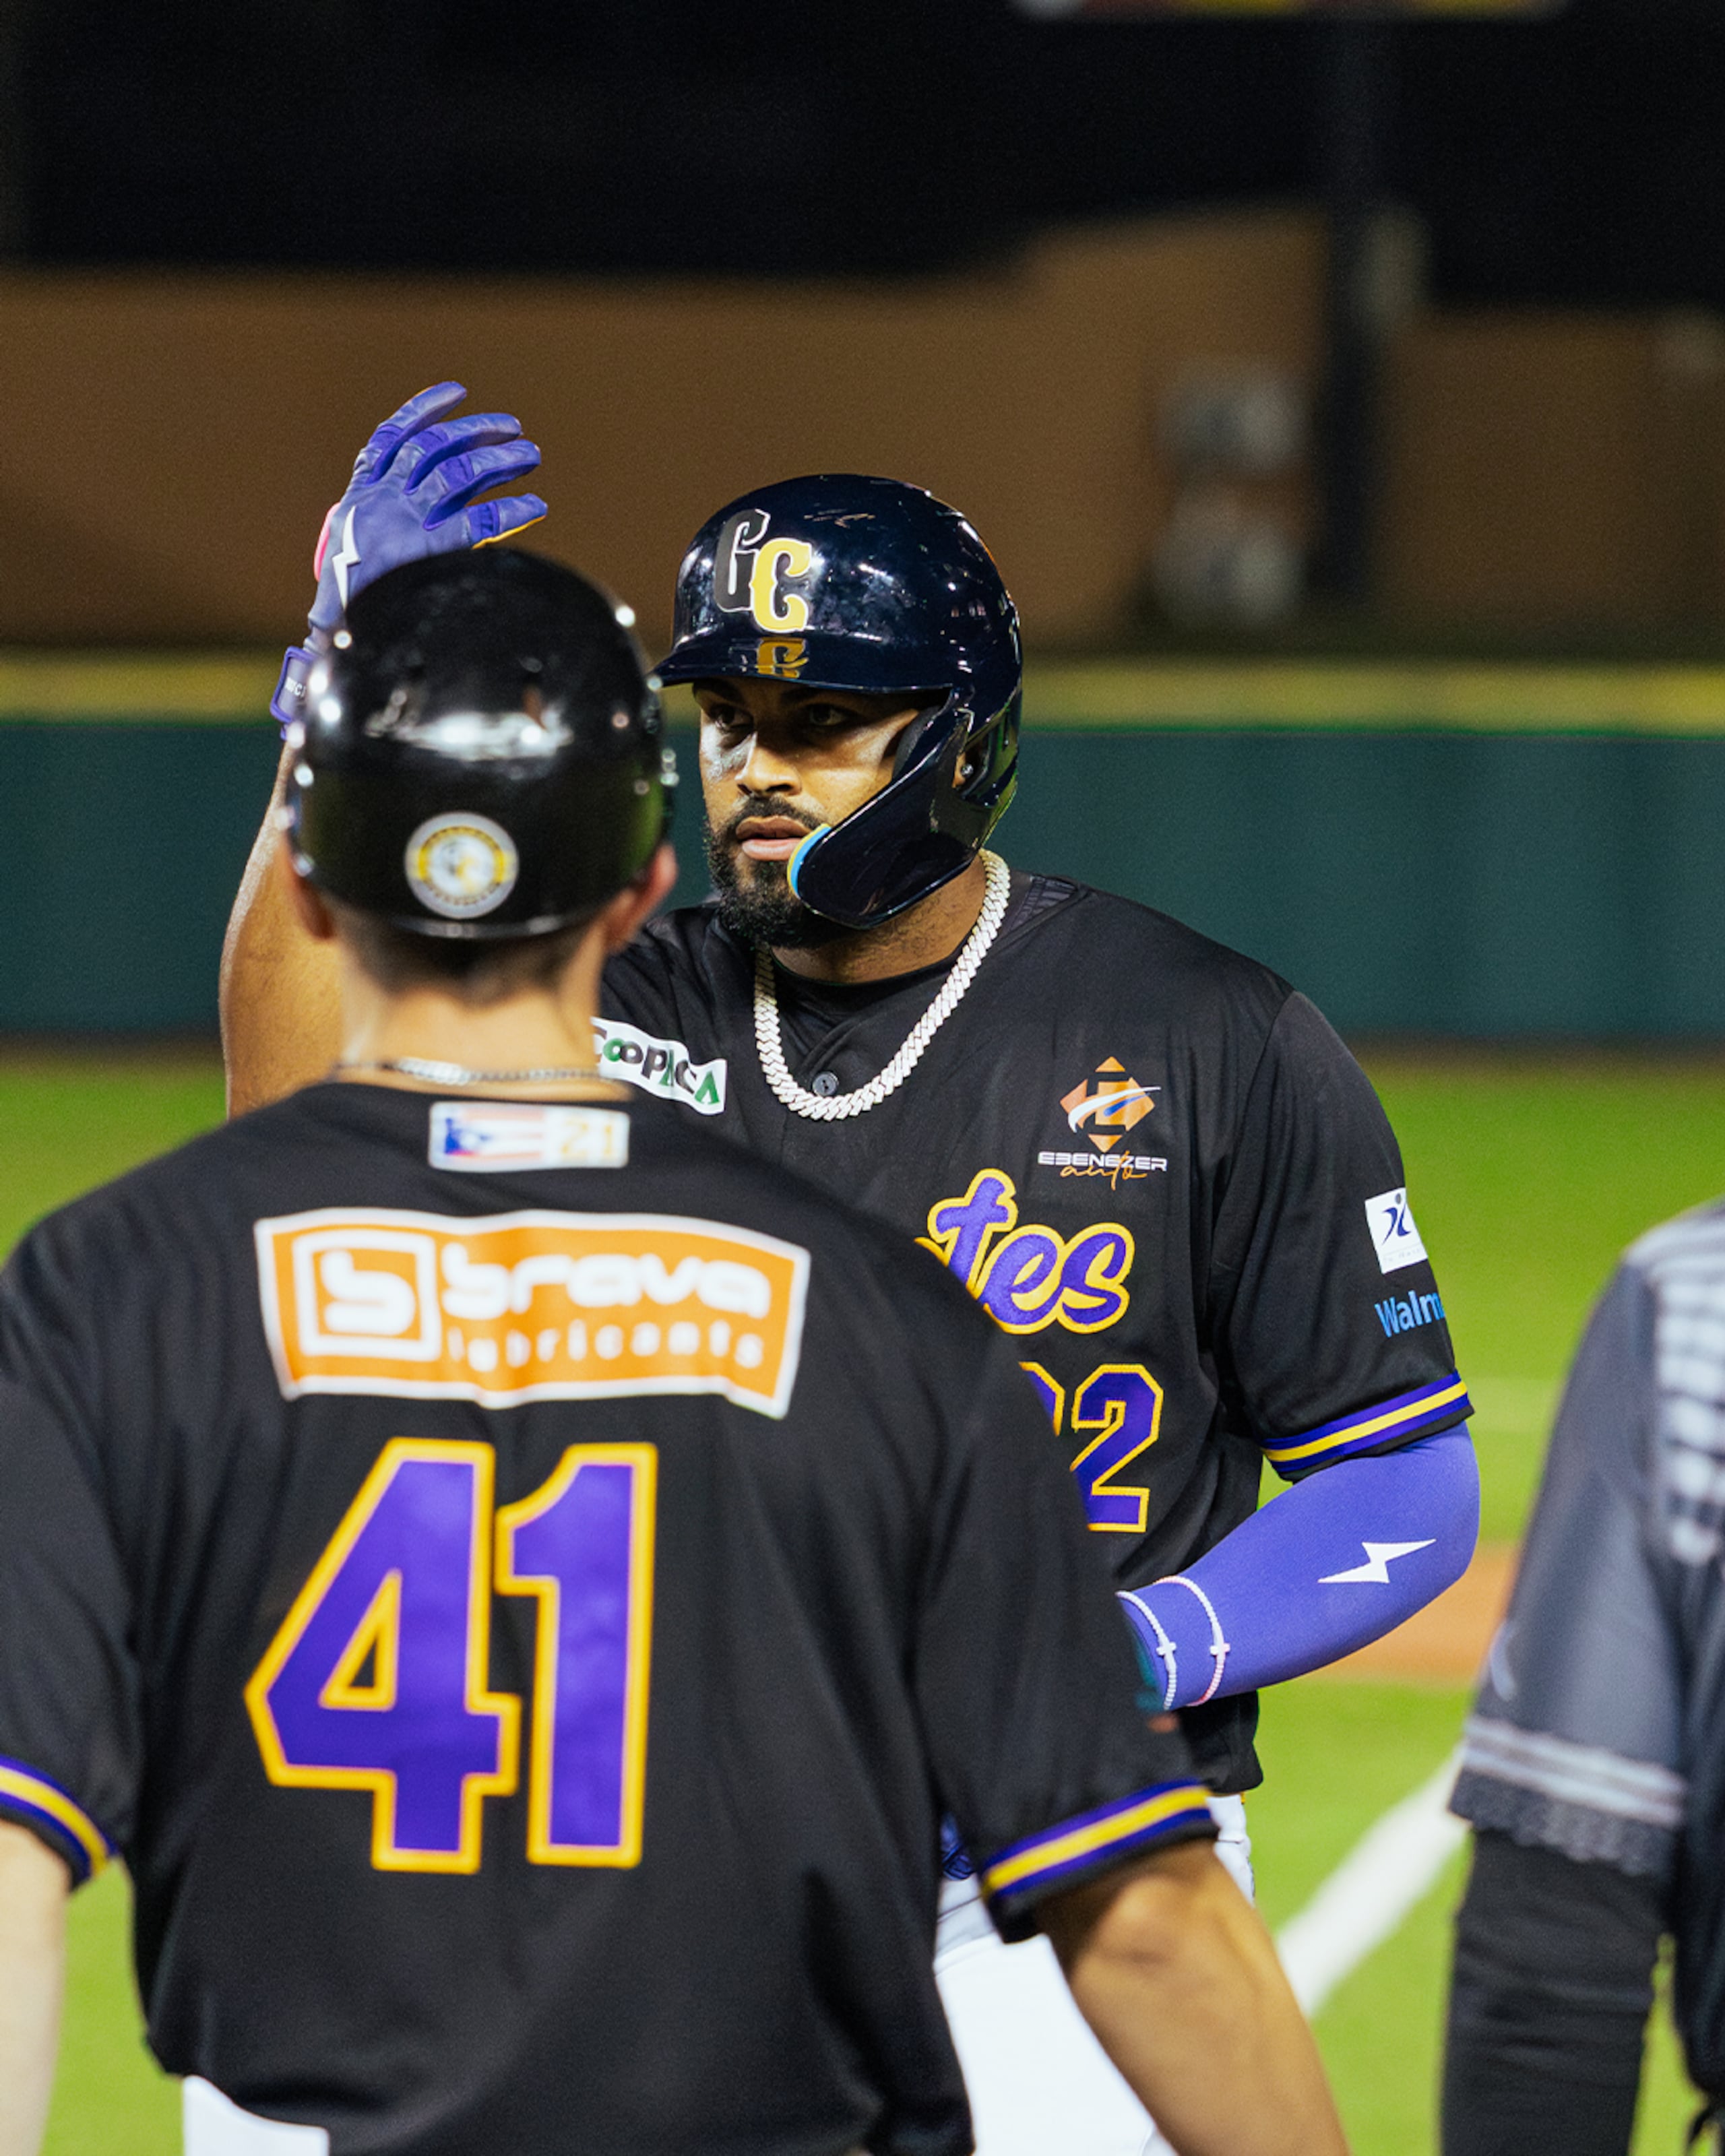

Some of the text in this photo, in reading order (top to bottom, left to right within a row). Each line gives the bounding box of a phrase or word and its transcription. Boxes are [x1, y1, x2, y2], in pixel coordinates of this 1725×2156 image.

[1037, 1151, 1168, 1171] EBENEZER
[1060, 1151, 1147, 1191] auto
[440, 1240, 772, 1319] brava
[914, 1168, 1135, 1335] tes
[1019, 1362, 1164, 1533] 2
[244, 1436, 658, 1874] 41
